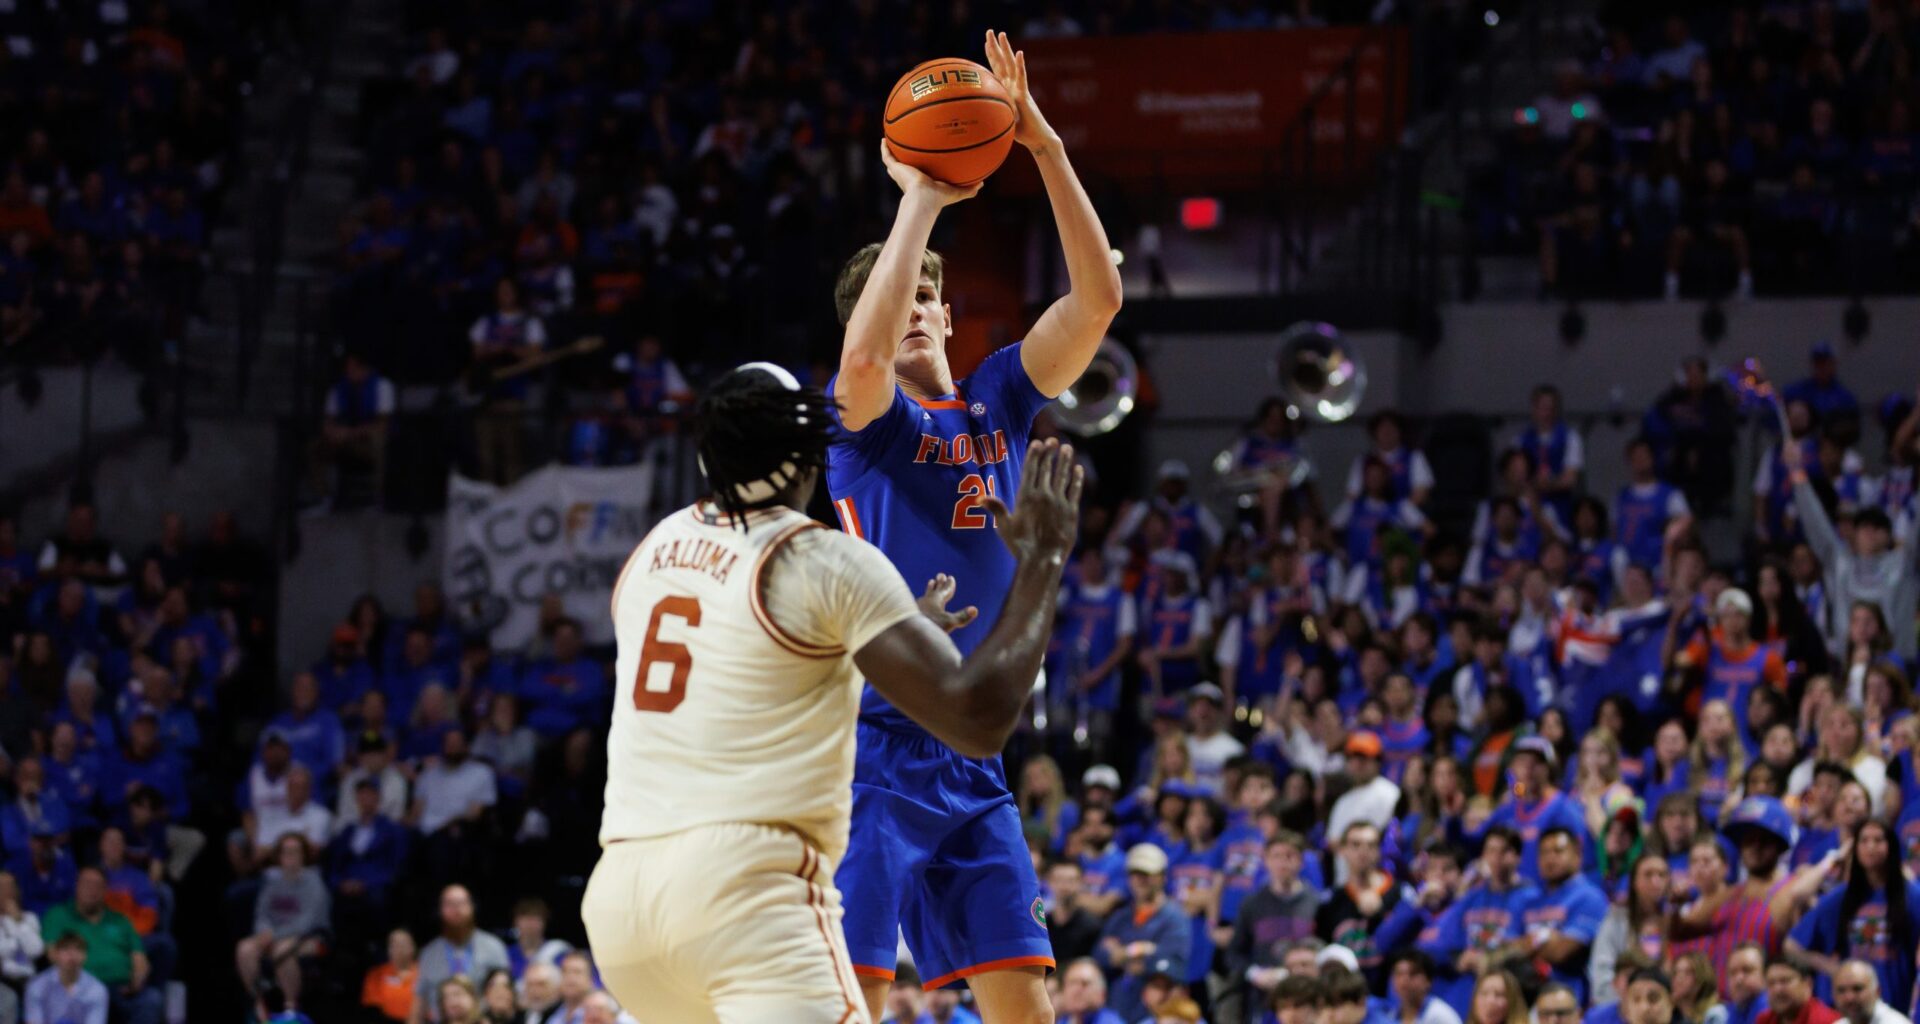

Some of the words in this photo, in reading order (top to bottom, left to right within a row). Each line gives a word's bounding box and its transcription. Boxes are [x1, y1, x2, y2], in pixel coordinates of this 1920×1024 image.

[909, 69, 982, 98] ELITE
[912, 429, 1010, 467] FLOIDA
[648, 539, 740, 585] KALUMA
[632, 594, 702, 714] 6
